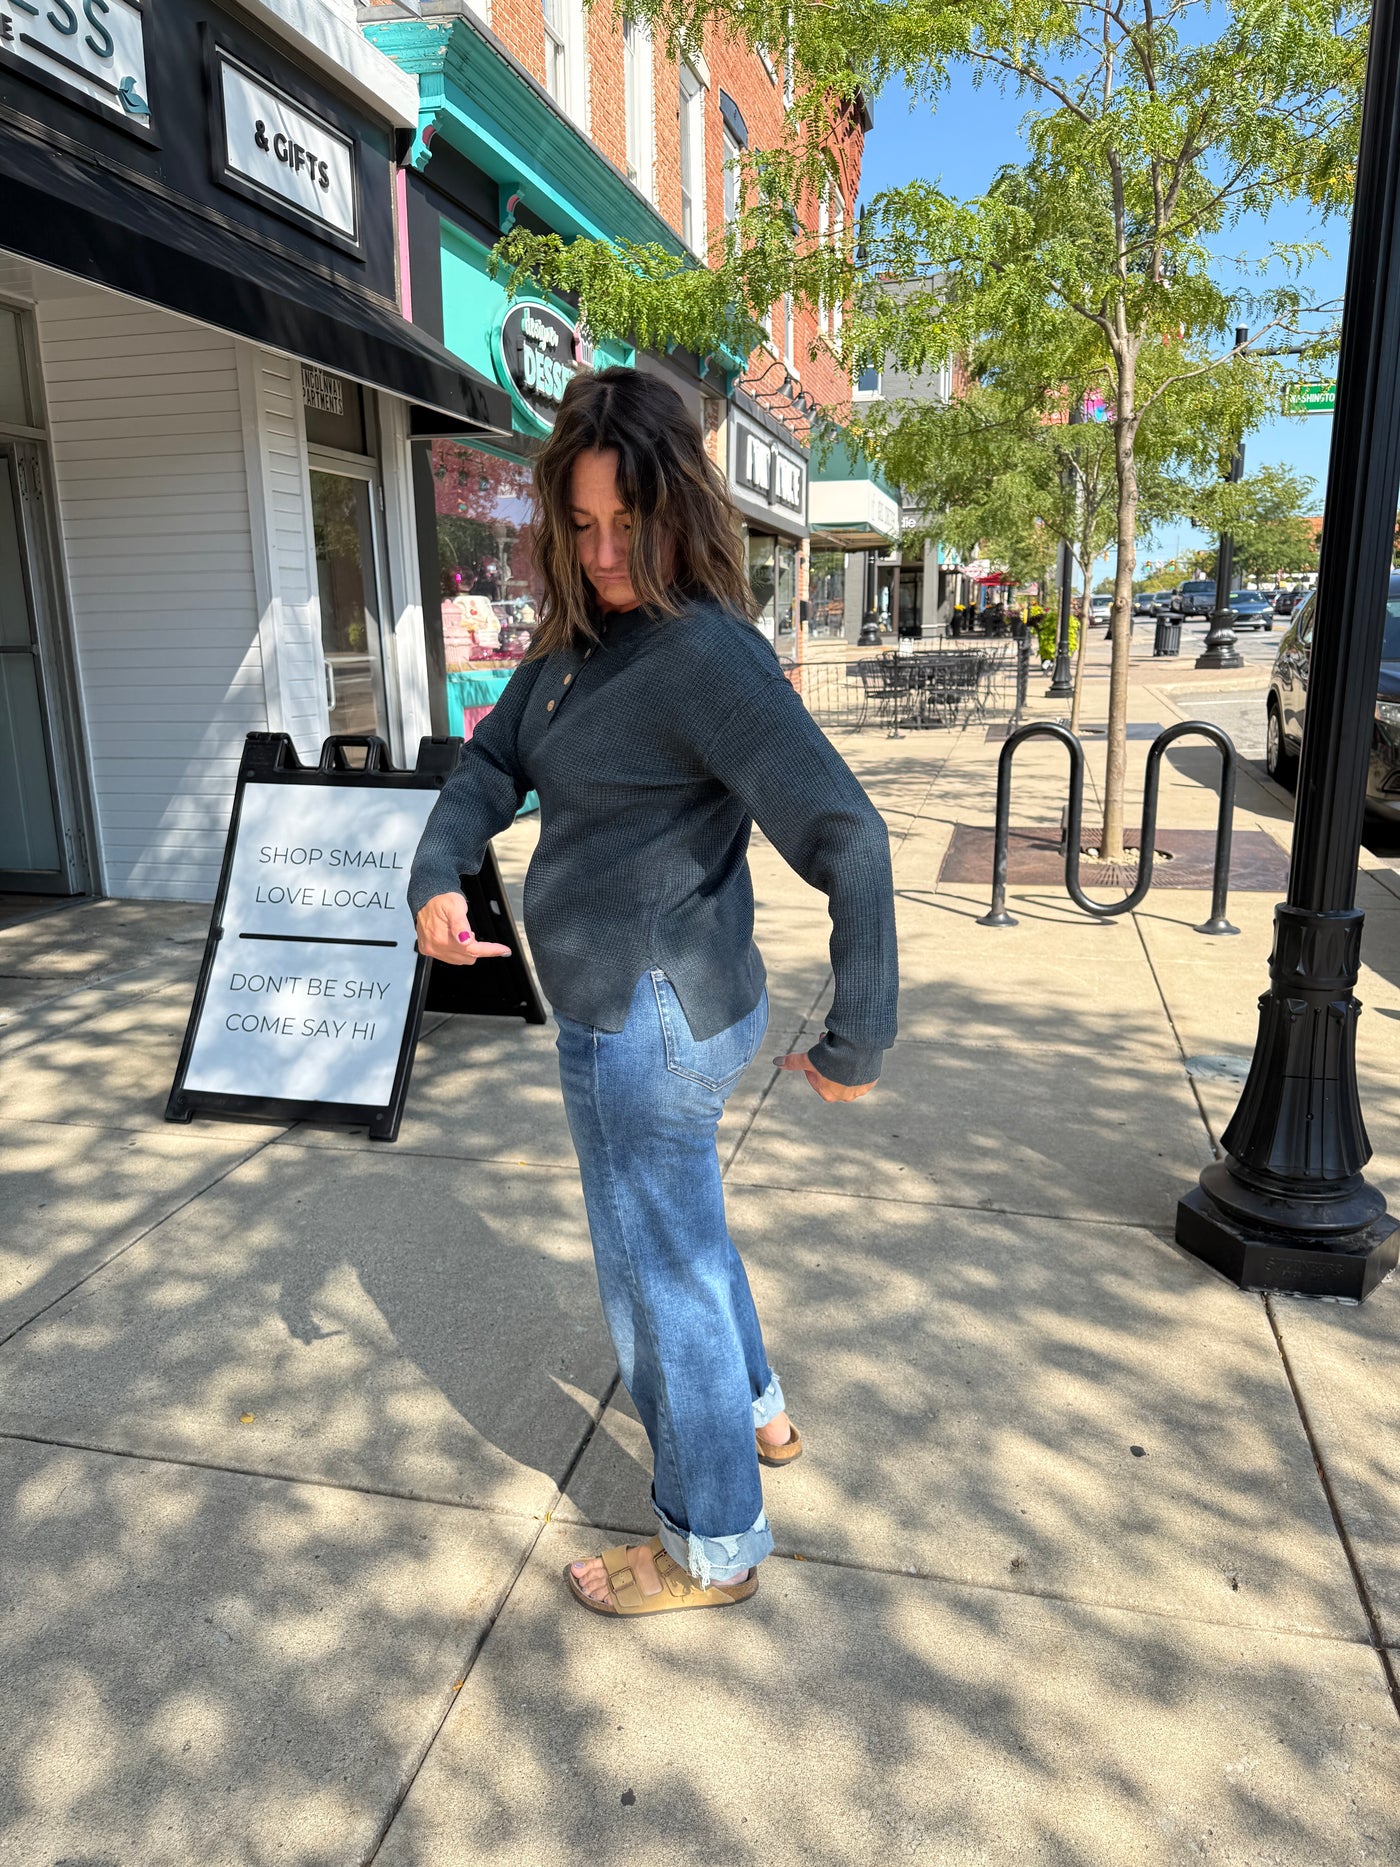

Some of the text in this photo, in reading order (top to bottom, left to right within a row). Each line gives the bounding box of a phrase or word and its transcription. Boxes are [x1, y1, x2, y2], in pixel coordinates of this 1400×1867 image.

[8, 0, 115, 58] SS
[254, 119, 330, 189] & GIFTS
[258, 846, 404, 870] SHOP SMALL
[255, 885, 396, 910] LOVE LOCAL
[229, 973, 392, 1001] DON'T BE SHY
[225, 1013, 376, 1041] COME SAY HI
